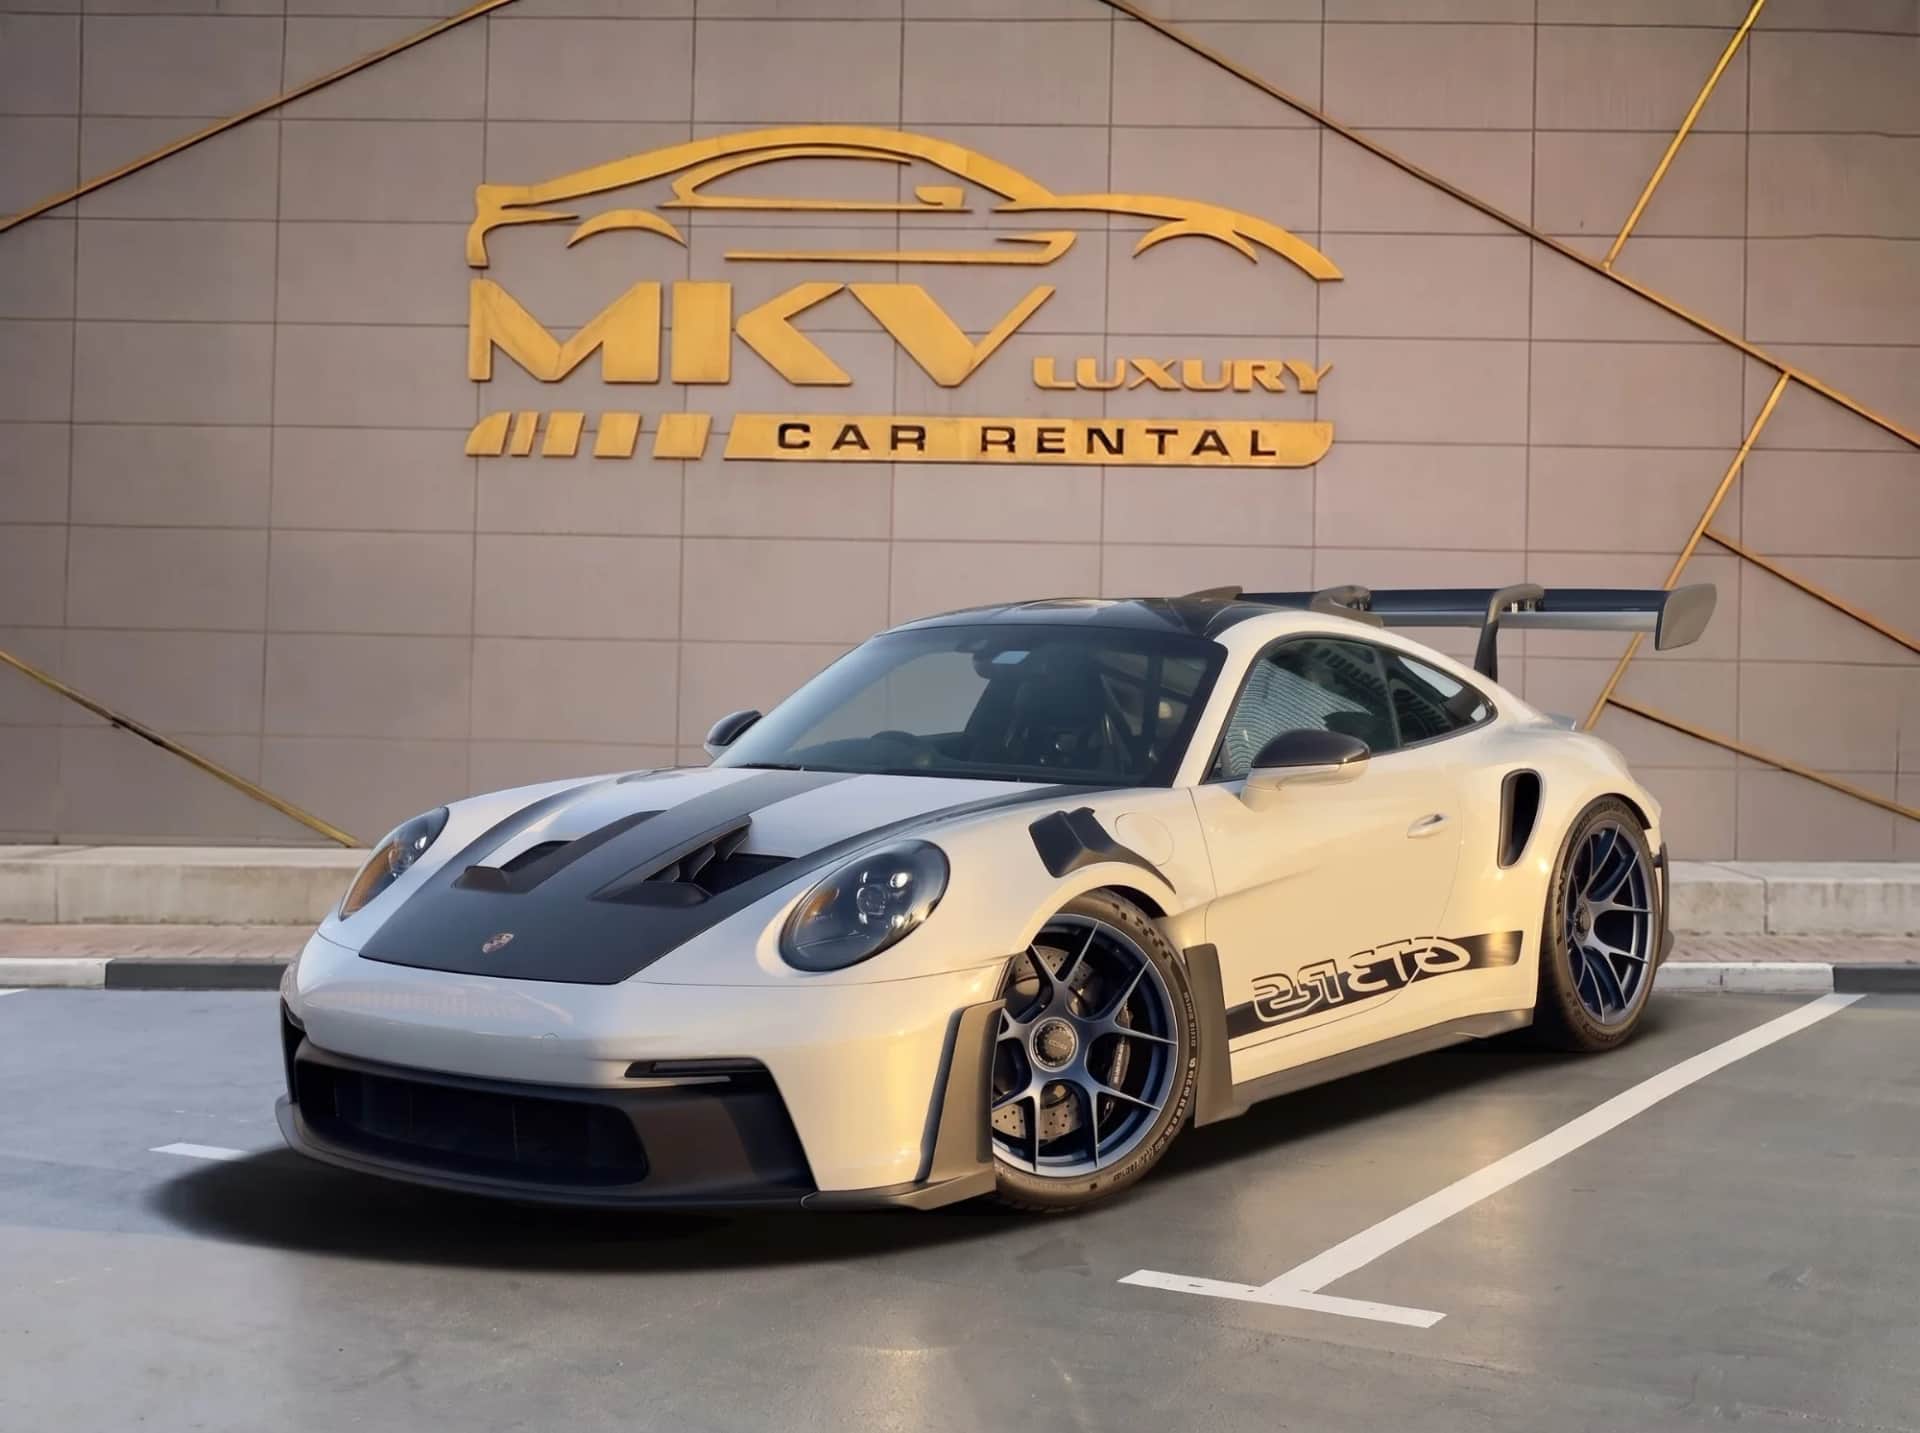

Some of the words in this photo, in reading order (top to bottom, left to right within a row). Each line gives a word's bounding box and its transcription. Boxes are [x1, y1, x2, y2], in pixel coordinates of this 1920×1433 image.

[468, 278, 1055, 386] MKV
[1033, 356, 1332, 392] LUXURY
[777, 422, 927, 452] CAR
[980, 426, 1277, 456] RENTAL
